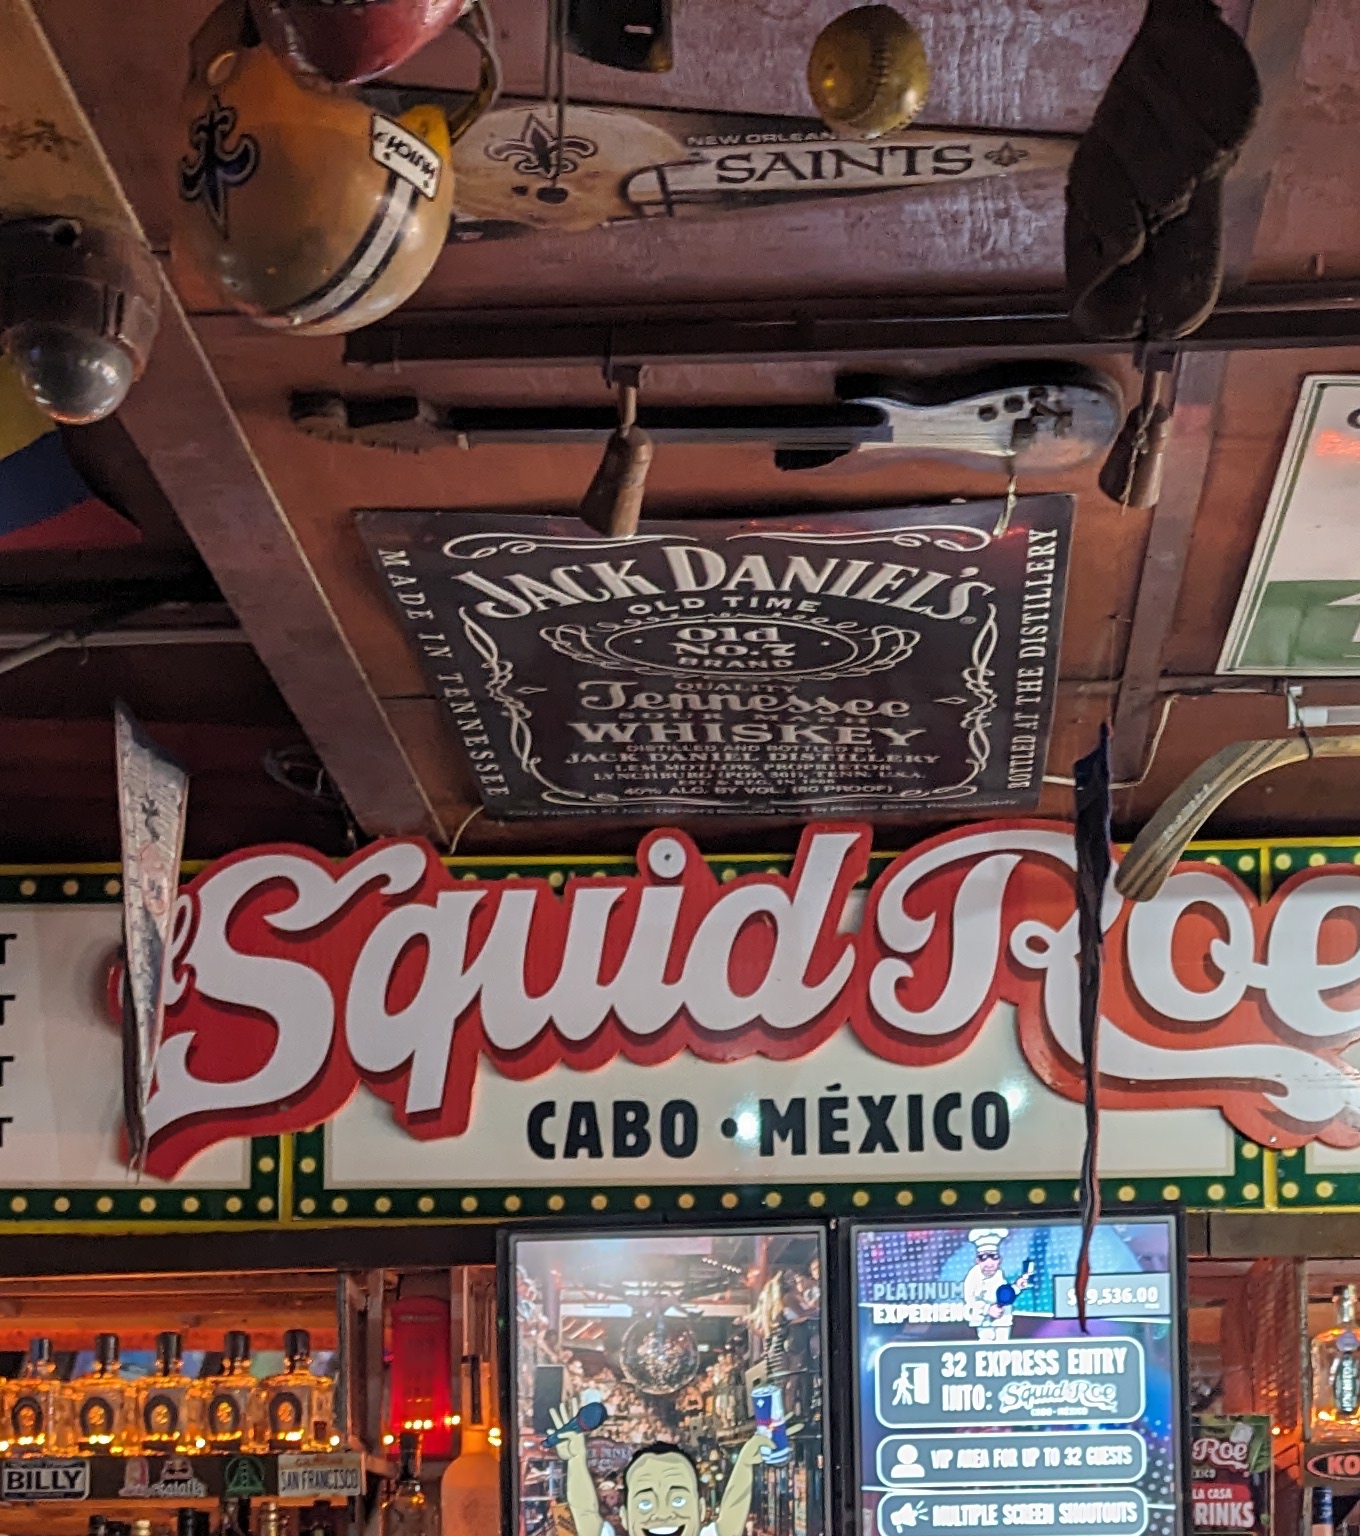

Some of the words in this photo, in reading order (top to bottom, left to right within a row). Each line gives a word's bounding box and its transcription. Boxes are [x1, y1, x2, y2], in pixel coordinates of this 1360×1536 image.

[687, 135, 741, 146] NEW
[715, 144, 974, 184] SAINTS
[450, 558, 666, 619] JACK
[660, 545, 996, 621] DANIEL'S
[1017, 527, 1060, 662] DISTILLERY
[627, 597, 706, 616] OLD
[721, 596, 822, 614] TIME
[676, 626, 782, 643] Old
[378, 548, 436, 621] MADE
[417, 632, 454, 660] IN
[436, 671, 511, 797] TENNESSEE
[678, 657, 794, 669] BRAND
[577, 679, 912, 719] Tennessee
[674, 681, 798, 694] QUALITY
[1015, 666, 1044, 707] THE
[618, 711, 724, 721] SOUR
[566, 721, 927, 748] WHISKEY
[565, 751, 639, 765] JACK
[649, 751, 760, 763] DANIEL
[767, 751, 941, 765] DISTILLERY
[148, 830, 860, 1124] Squid
[524, 1098, 702, 1162] CABO
[758, 1083, 1012, 1156] MÉXICO
[873, 1281, 965, 1302] PLATINUM
[940, 1352, 967, 1379] 32
[975, 1349, 1061, 1378] EXPRESS
[1067, 1347, 1129, 1375] ENTRY
[941, 1383, 994, 1412] INTO:
[930, 1449, 954, 1470] VIP
[956, 1448, 990, 1469] AREA
[992, 1448, 1019, 1469] FOR
[1021, 1447, 1040, 1468] UP
[1042, 1447, 1061, 1468] TO
[1063, 1446, 1083, 1467] 32
[1085, 1445, 1134, 1467] GUESTS
[1191, 1437, 1250, 1470] Roe
[6, 1469, 83, 1491] BILLY
[281, 1471, 303, 1493] SAN
[303, 1468, 360, 1492] FRANCISCO
[1207, 1488, 1233, 1500] CASA
[931, 1504, 999, 1528] MULTIPLE
[1002, 1503, 1055, 1526] SCREEN
[1058, 1501, 1138, 1525] SHOUTOUTS
